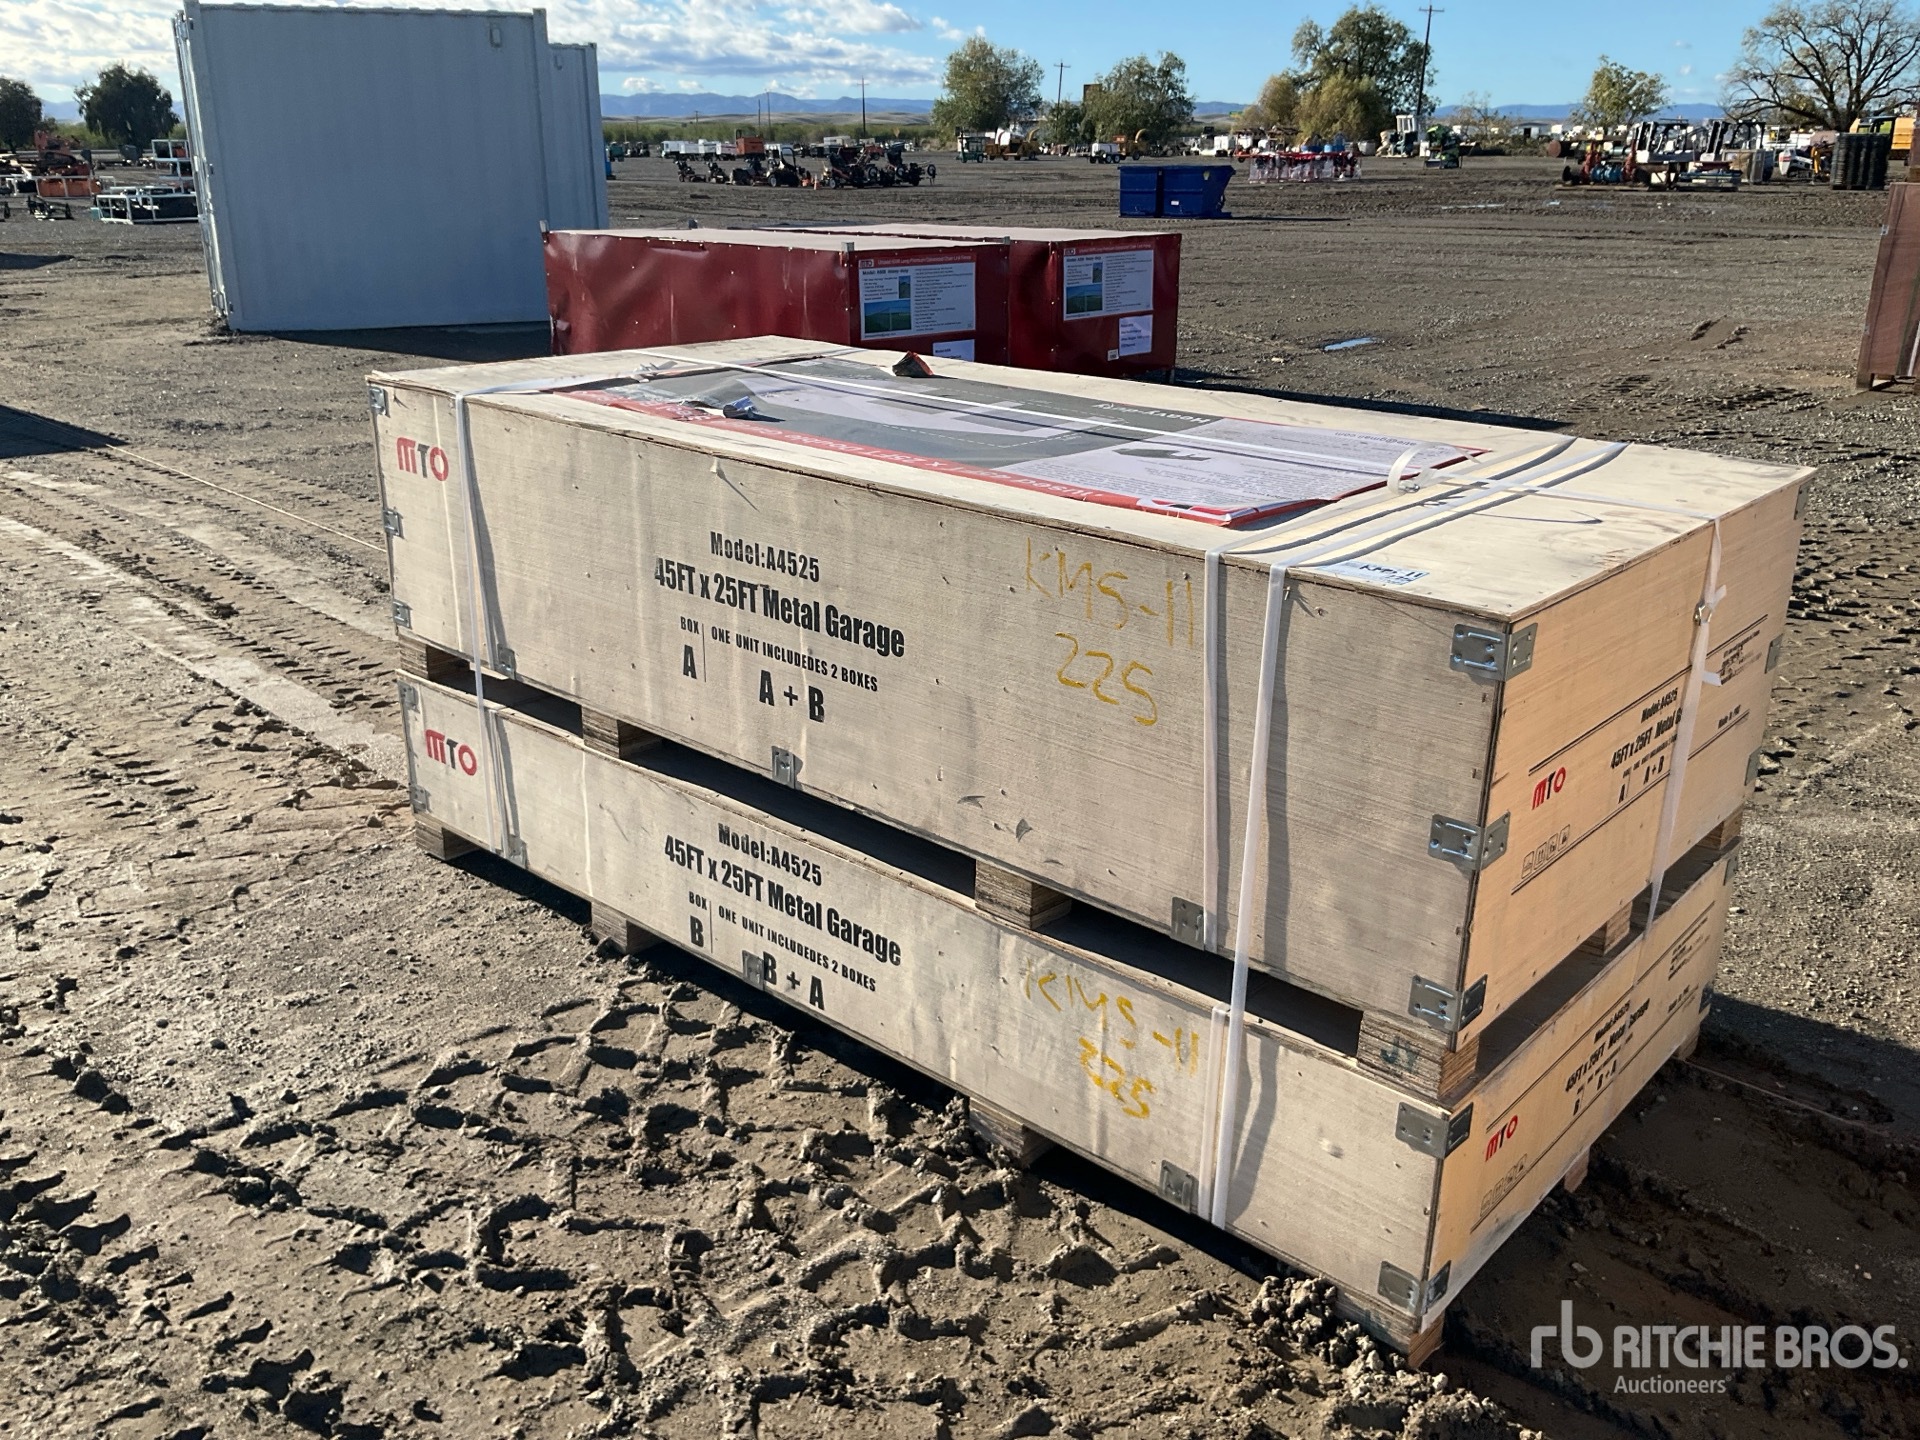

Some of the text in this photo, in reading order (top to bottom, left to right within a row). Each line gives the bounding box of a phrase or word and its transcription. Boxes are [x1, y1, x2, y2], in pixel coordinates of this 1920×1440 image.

[396, 437, 450, 482] MTO
[710, 531, 820, 582] Model:A4525
[654, 557, 905, 657] 45FT x 25FT Metal Garage
[680, 616, 700, 635] BOX
[683, 644, 697, 680] A
[711, 626, 879, 692] ONE UNIT INCLUDEDES 2 BOXES
[759, 669, 825, 723] A + B
[425, 729, 478, 776] MTO
[1634, 727, 1653, 753] 25FT
[1532, 766, 1566, 810] MTO
[717, 822, 822, 887] Model:A4525
[664, 834, 902, 966] 45FT x 25FT Metal Garage
[689, 891, 708, 911] BOX
[690, 915, 705, 948] B
[718, 905, 877, 992] ONE UNIT INCLUDEDES 2 BOXES
[763, 951, 826, 1011] B + A
[1485, 1114, 1518, 1162] MTO
